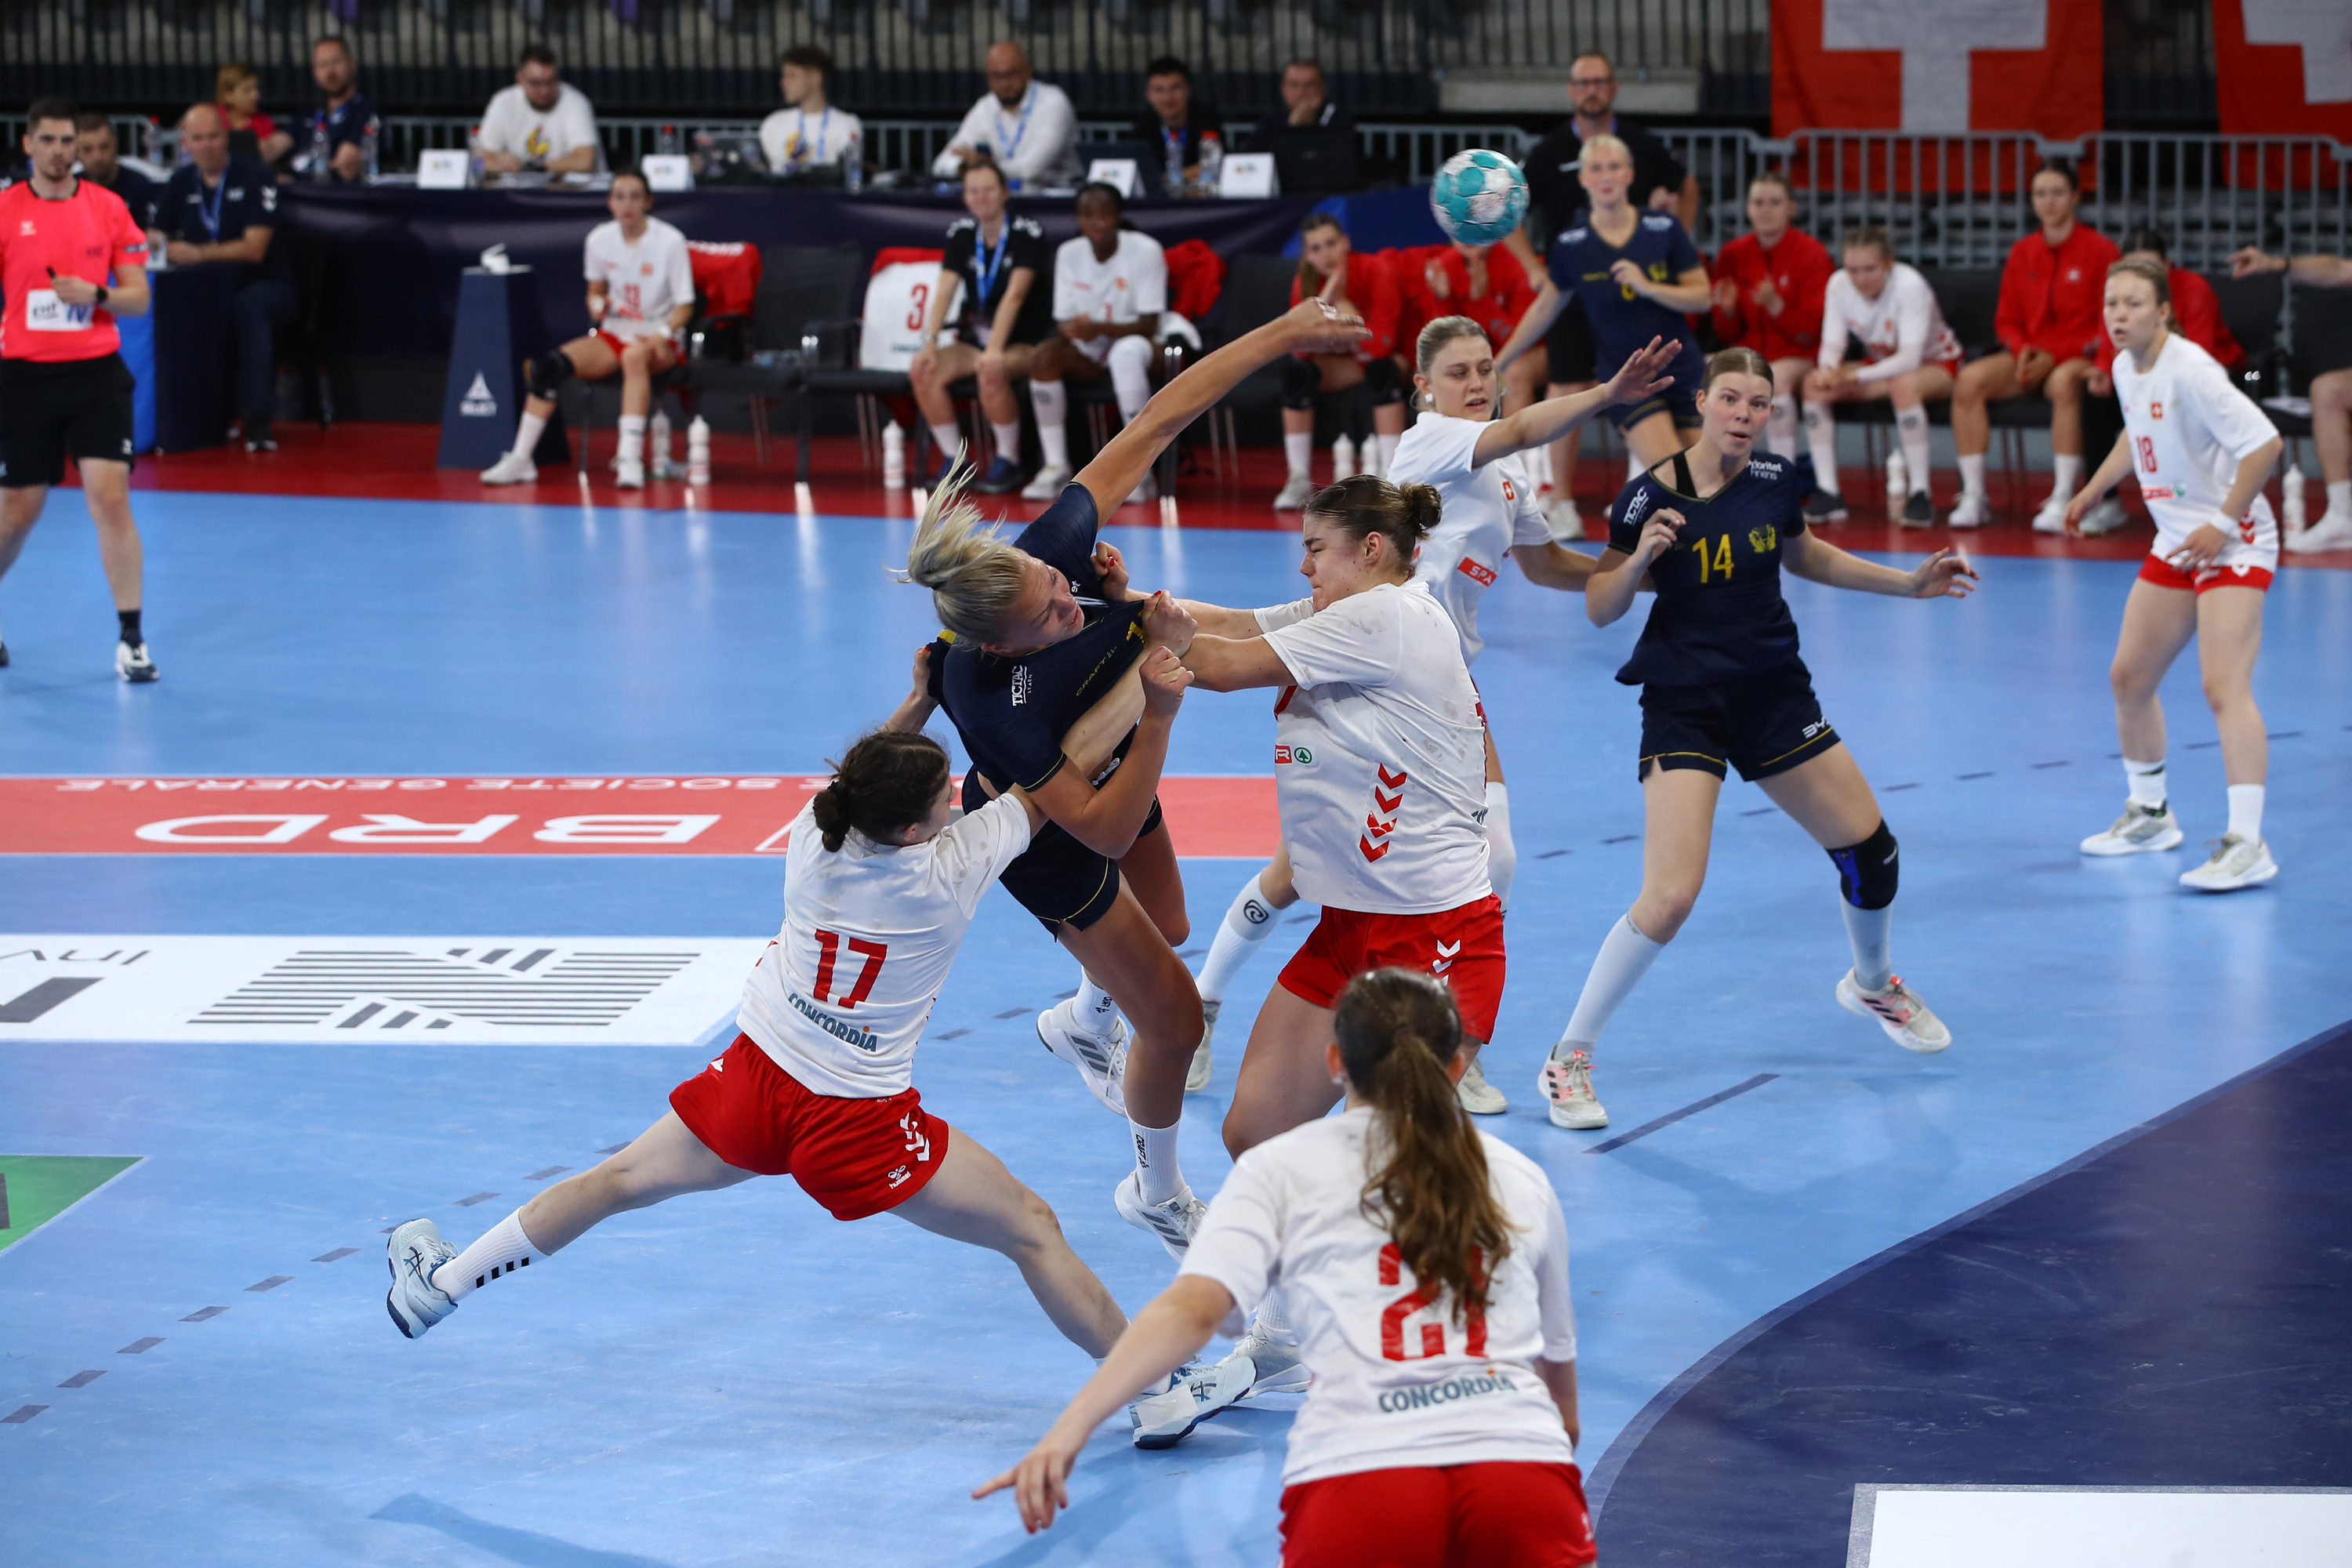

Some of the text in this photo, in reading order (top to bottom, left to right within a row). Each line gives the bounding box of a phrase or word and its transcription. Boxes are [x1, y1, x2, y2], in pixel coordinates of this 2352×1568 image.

[907, 283, 929, 331] 3
[2136, 436, 2158, 474] 18
[1624, 485, 1649, 524] TICTAC
[1692, 533, 1735, 583] 14
[1011, 665, 1024, 706] TICTAC
[56, 778, 448, 791] GENERALE
[135, 813, 722, 844] BRD
[814, 928, 888, 1009] 17
[888, 1171, 912, 1189] hummel
